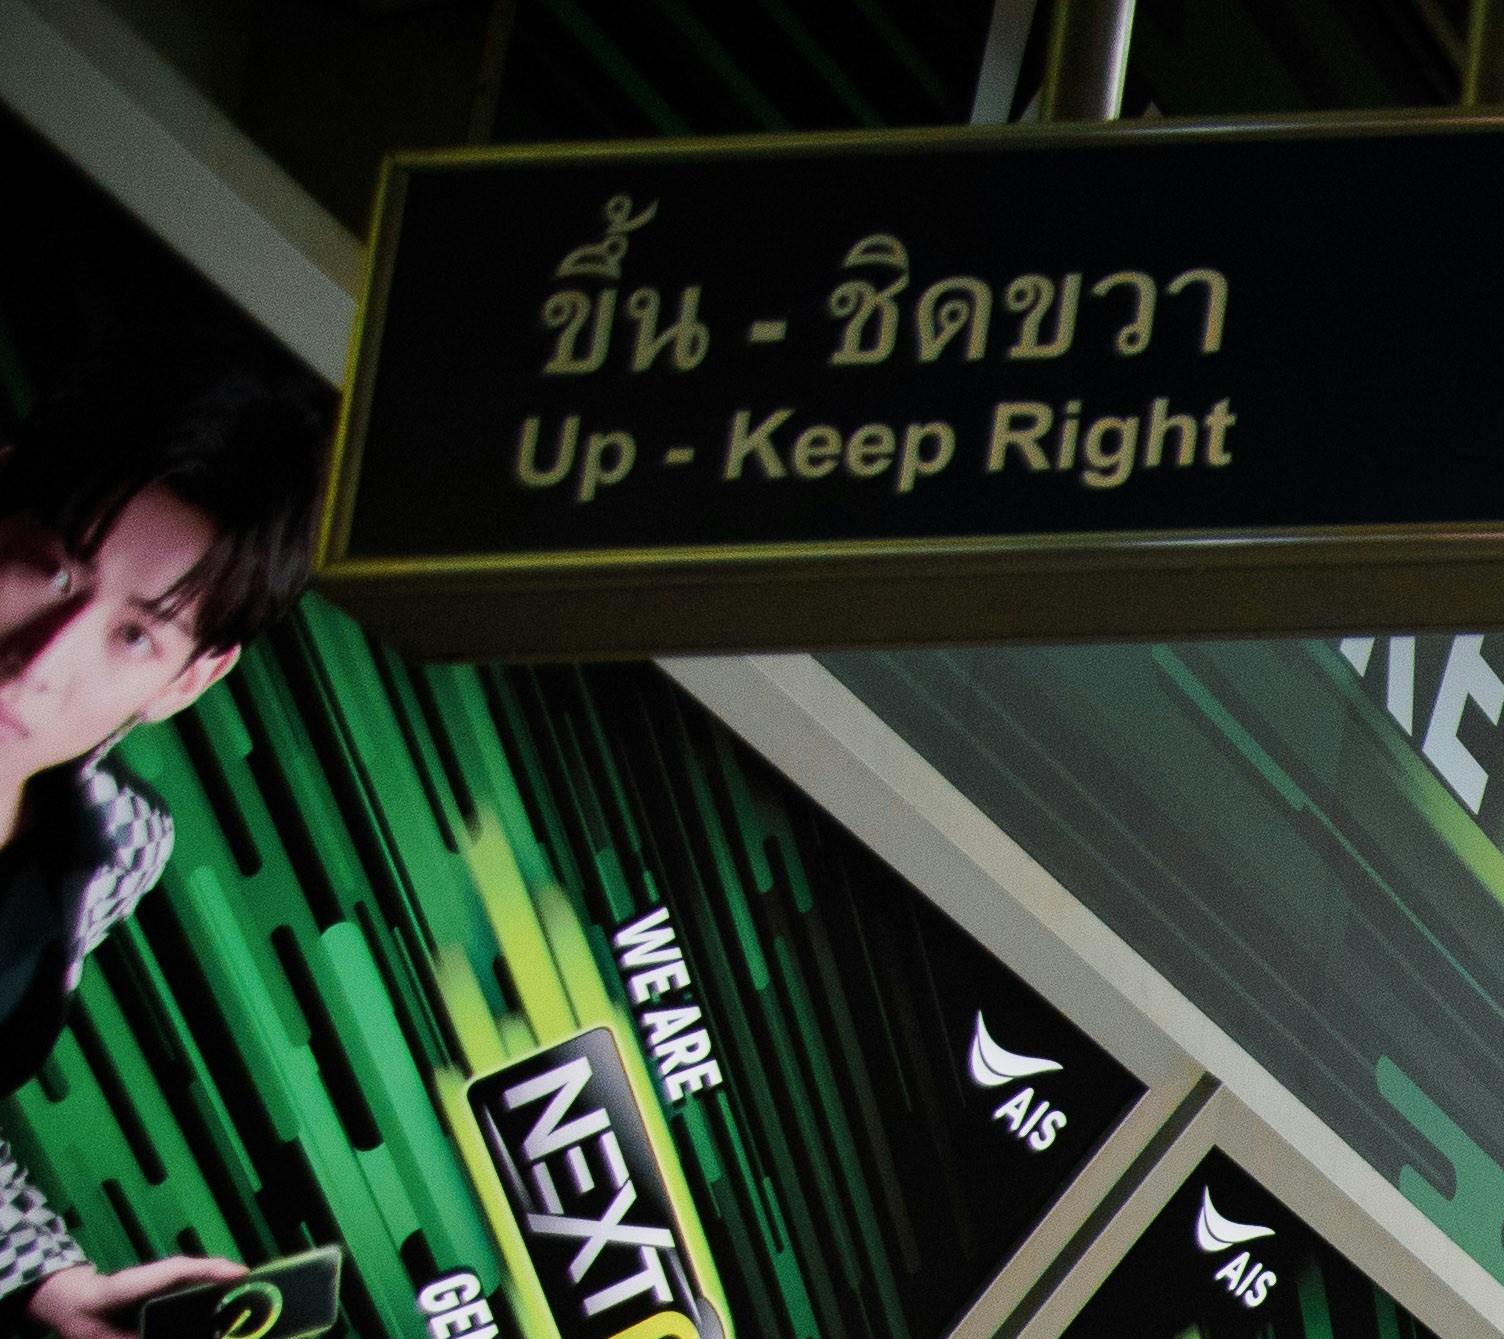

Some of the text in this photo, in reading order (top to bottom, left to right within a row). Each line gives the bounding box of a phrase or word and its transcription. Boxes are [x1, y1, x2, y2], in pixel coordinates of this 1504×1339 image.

[539, 193, 711, 377] ขึ้น
[826, 233, 1230, 367] ชิดขวา
[515, 414, 636, 503] Up
[722, 407, 955, 493] Keep
[987, 398, 1236, 489] Right
[614, 905, 723, 1105] WE ARE
[995, 1086, 1068, 1153] AIS
[1215, 1249, 1278, 1309] AIS
